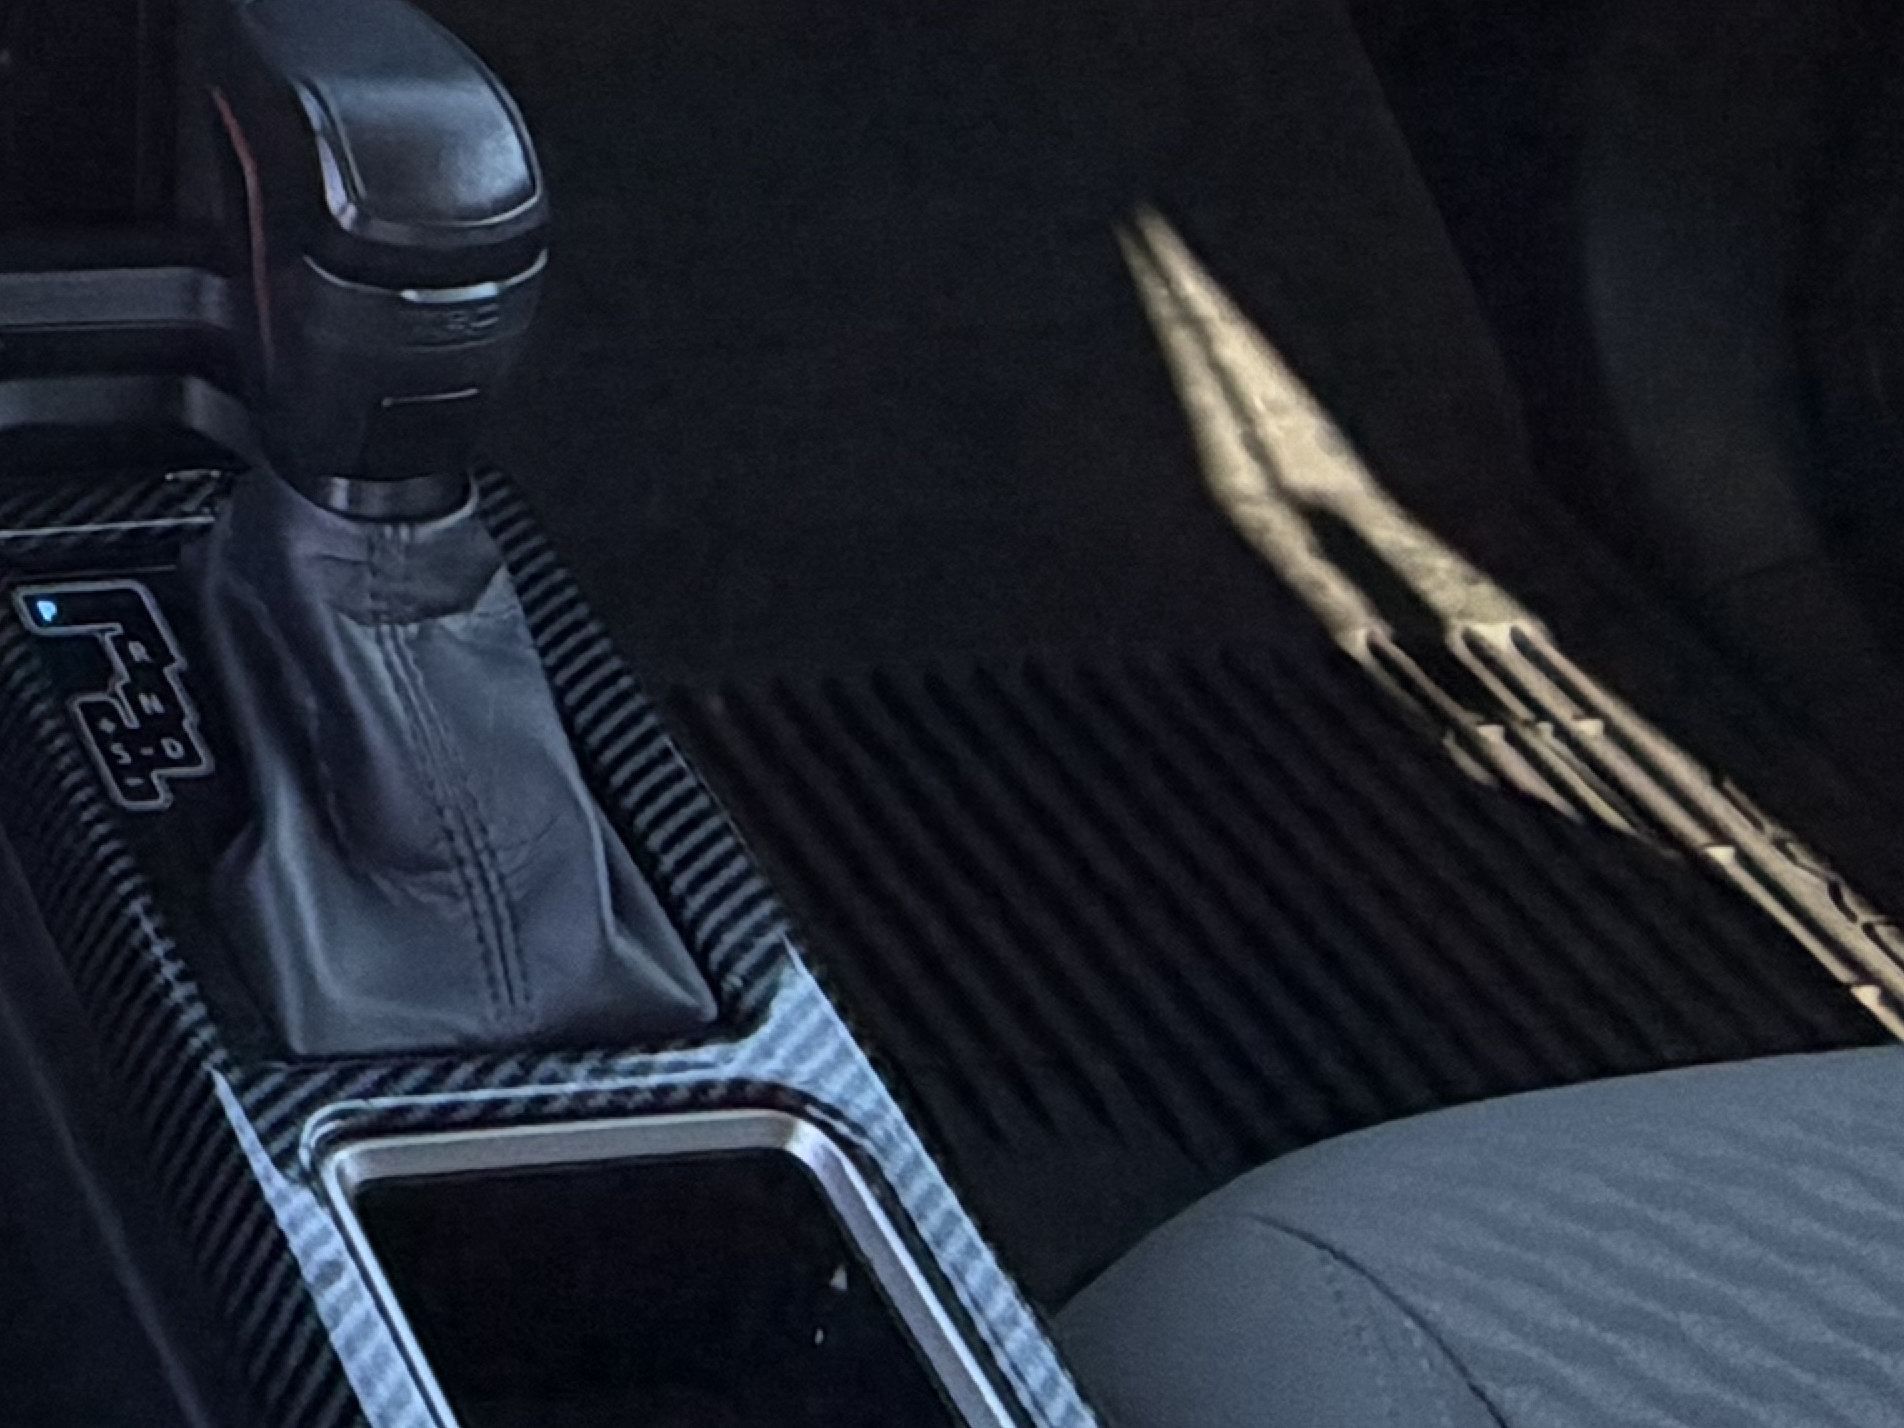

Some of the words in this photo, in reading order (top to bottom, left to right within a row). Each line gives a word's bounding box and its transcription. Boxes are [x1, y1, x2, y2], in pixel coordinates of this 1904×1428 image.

[128, 641, 154, 664] R
[138, 693, 166, 715] N
[161, 737, 186, 760] D
